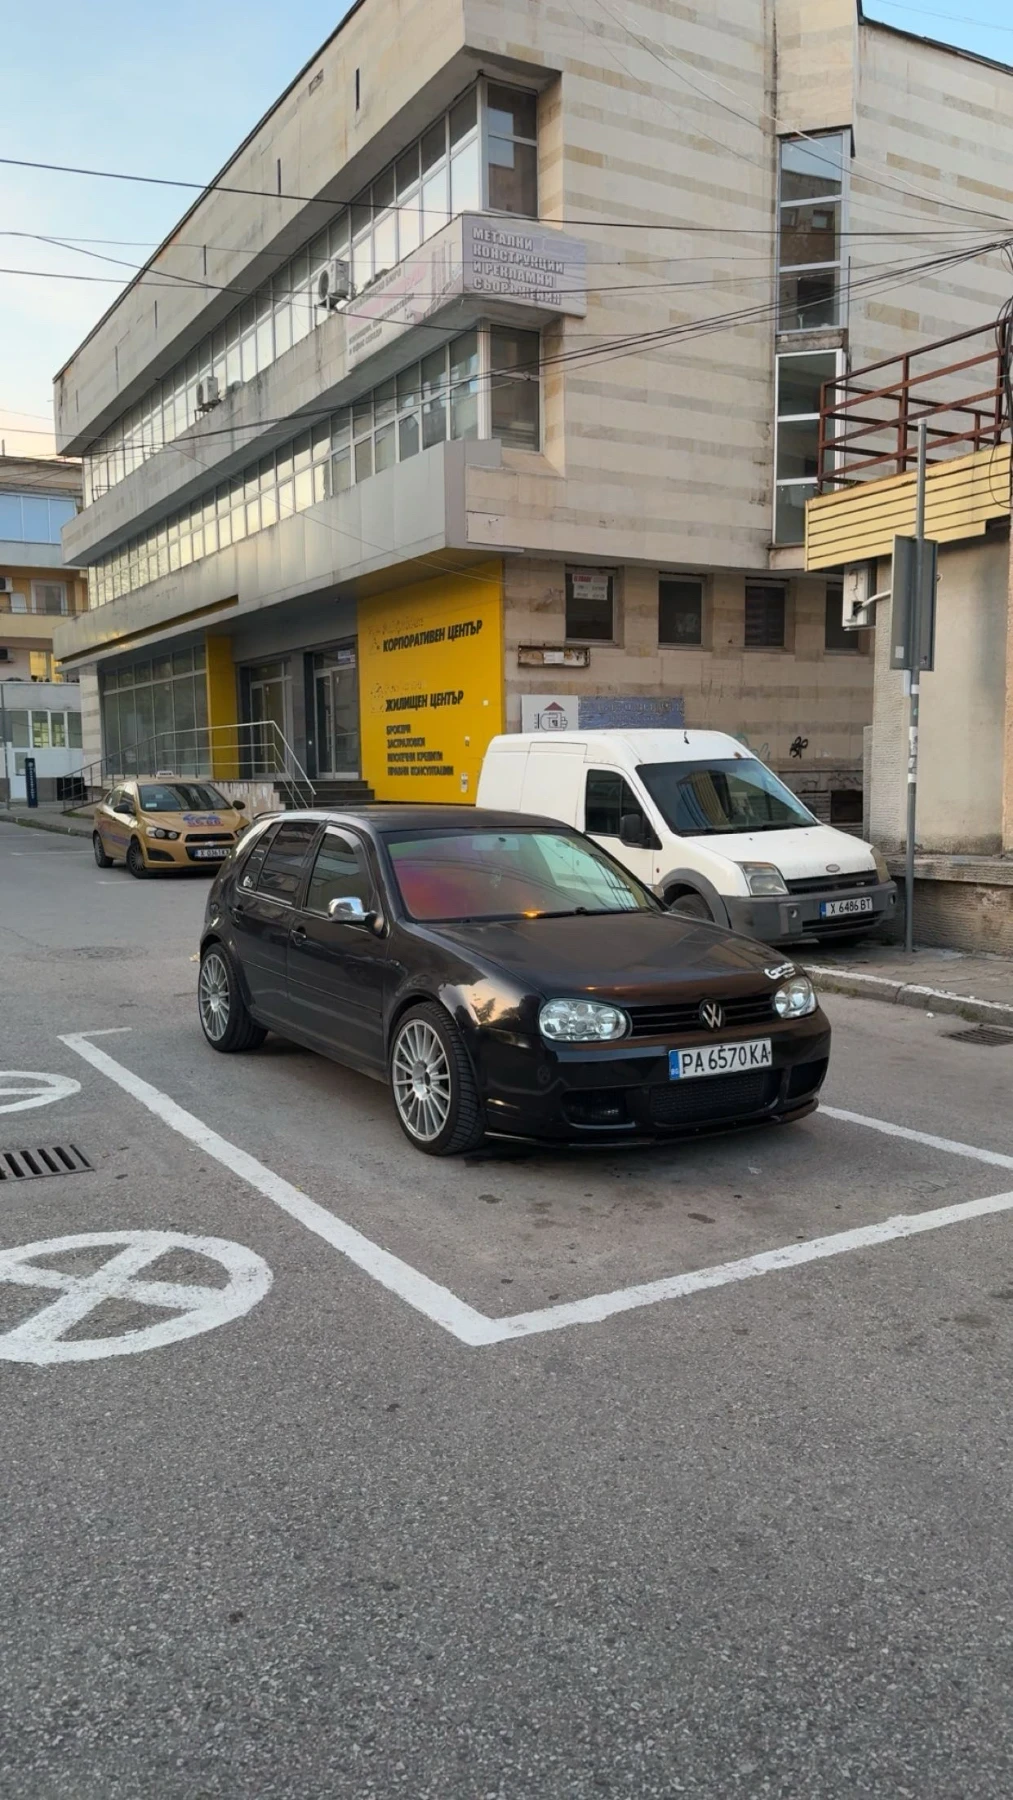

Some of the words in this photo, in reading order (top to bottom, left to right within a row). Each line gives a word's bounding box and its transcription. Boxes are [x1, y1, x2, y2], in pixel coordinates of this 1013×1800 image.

[472, 227, 533, 251] МЕТАЛНИ
[473, 244, 564, 274] КОНСТРУКЦИИ
[473, 261, 482, 274] И
[485, 262, 553, 288] РЕКЛАМНИ
[383, 627, 446, 652] КОРПОРАТИВЕН
[447, 619, 483, 642] ЦЕНТЪР
[385, 693, 428, 712] ЖИЛИЩЕН
[430, 690, 464, 709] ЦЕНТЪР
[830, 903, 836, 914] X
[838, 901, 859, 913] 6486
[861, 898, 871, 910] BT
